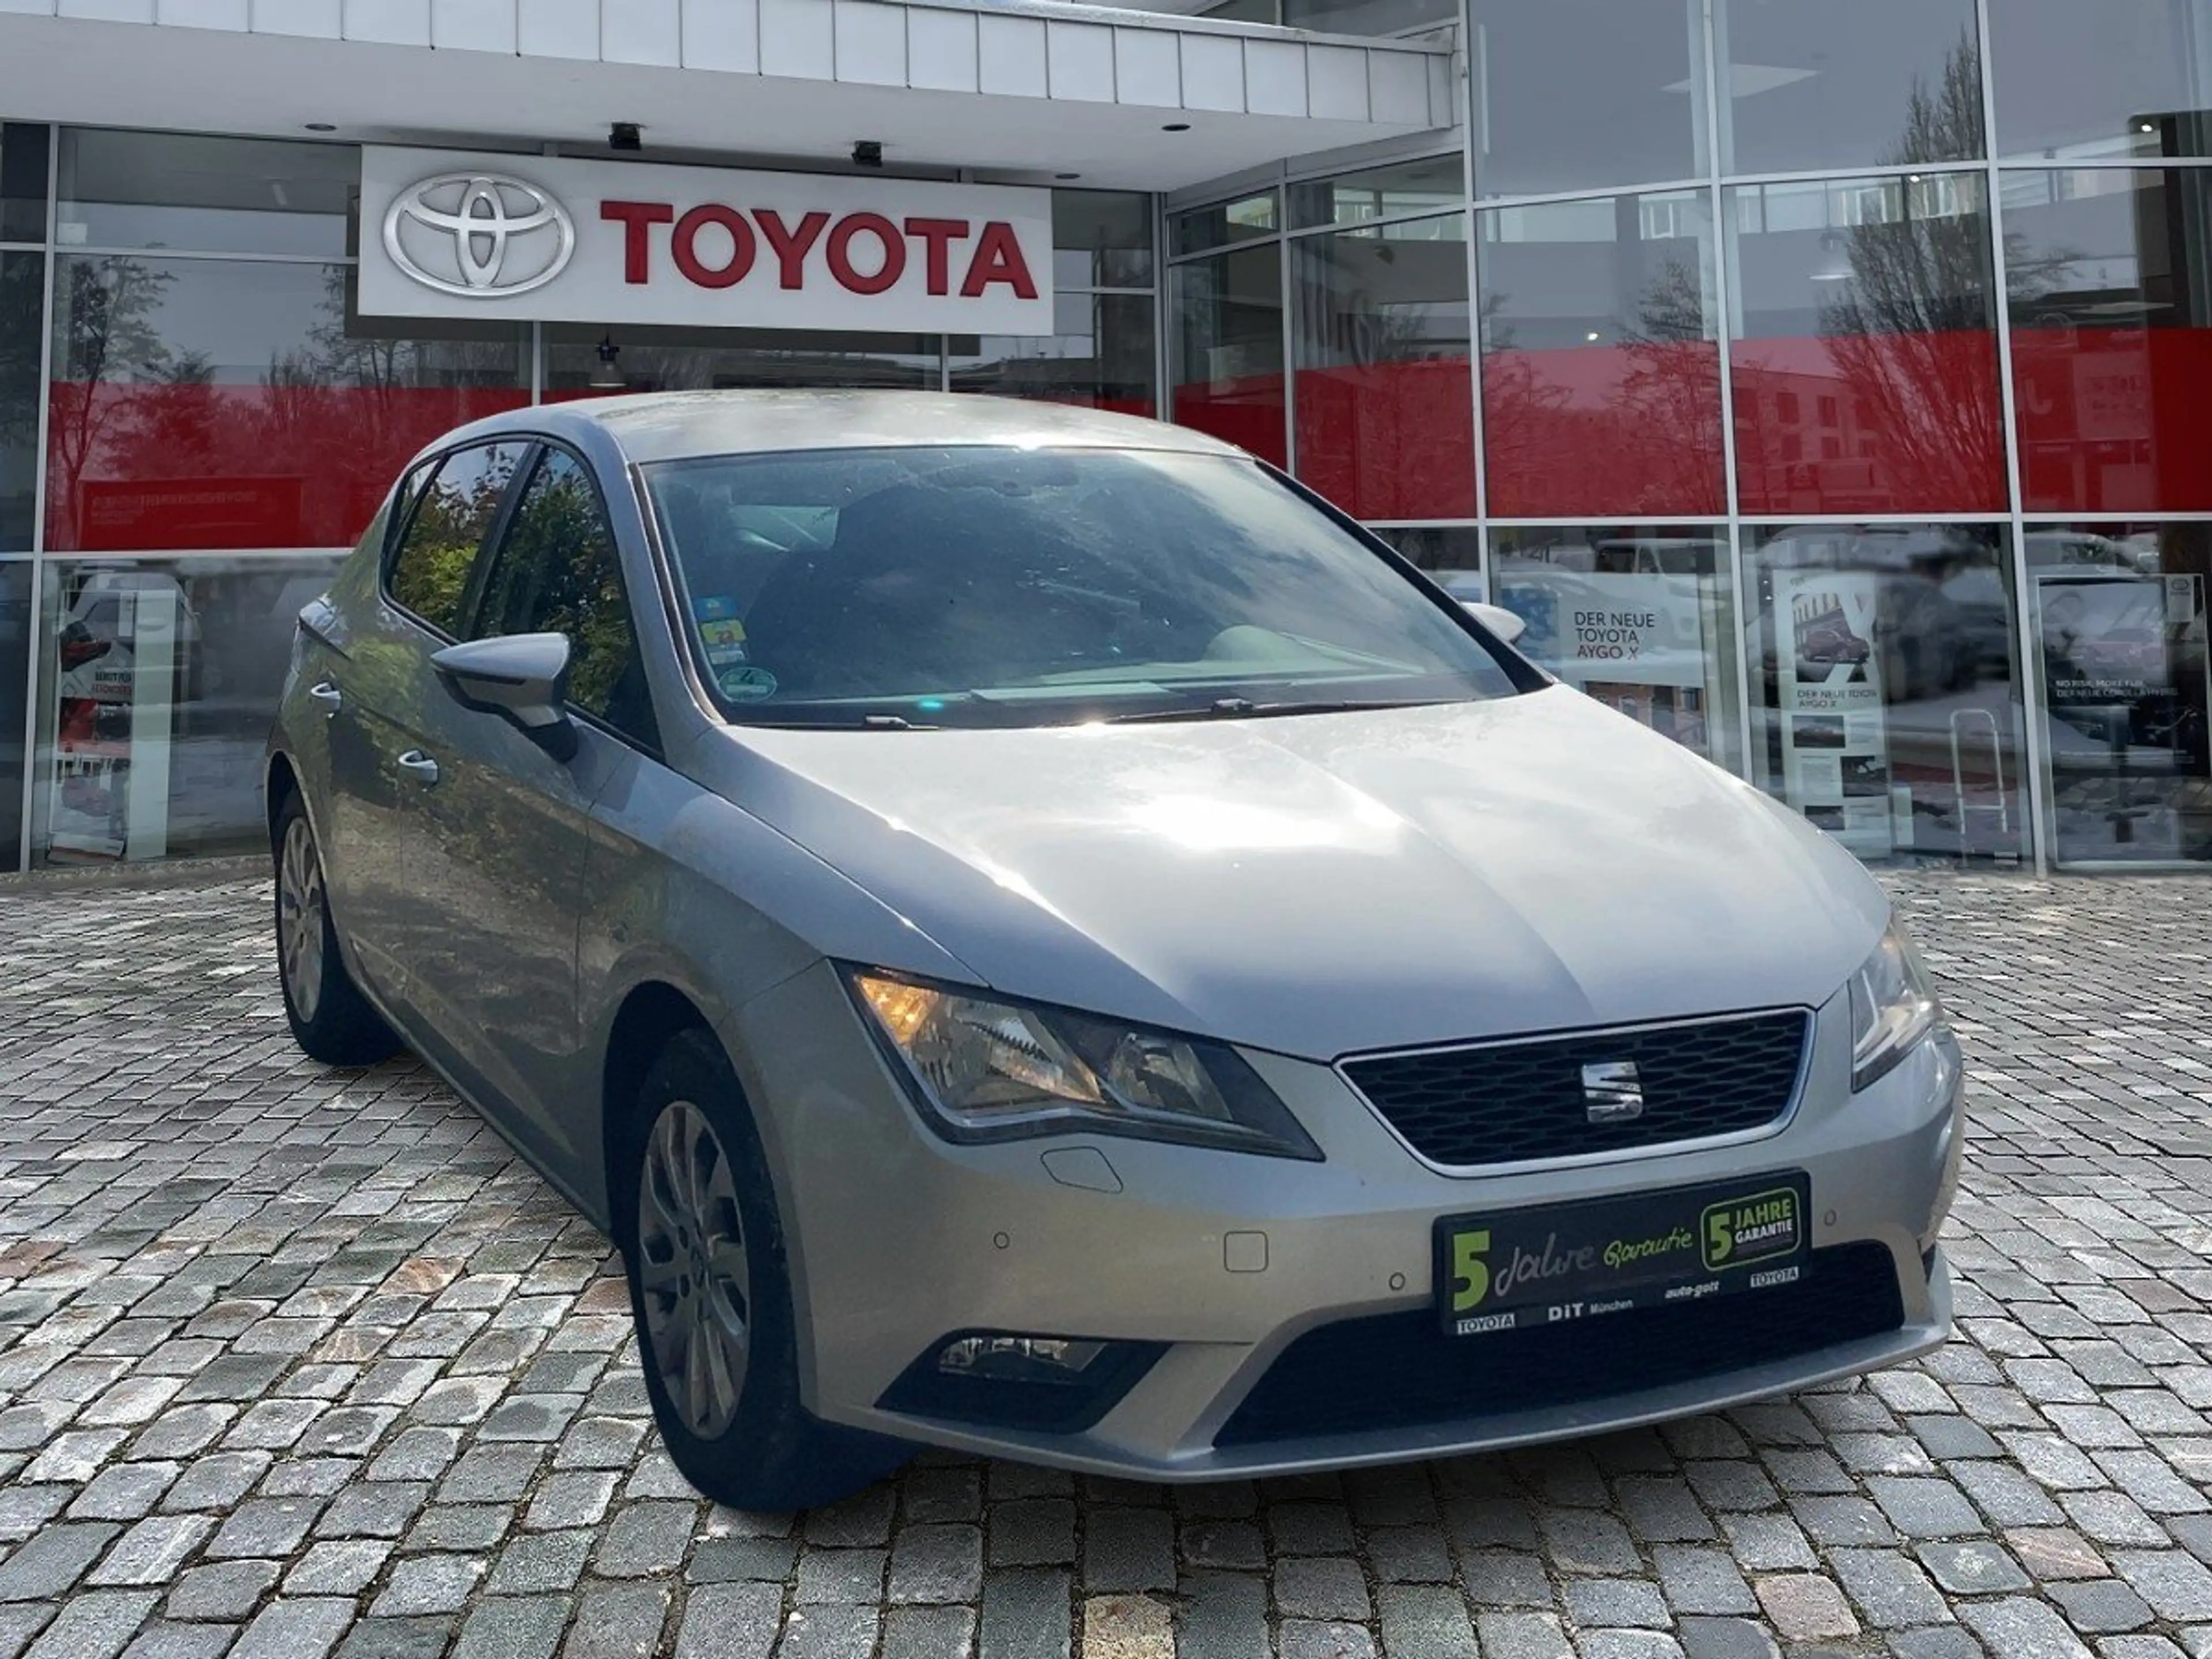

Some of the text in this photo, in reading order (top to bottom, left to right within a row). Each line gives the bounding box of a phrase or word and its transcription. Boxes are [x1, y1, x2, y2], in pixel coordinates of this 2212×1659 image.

[600, 200, 1038, 300] TOYOTA
[1575, 611, 1655, 628] DER NEUE
[1575, 627, 1639, 643] TOYOTA
[1577, 645, 1639, 660] AYGO X
[1735, 1198, 1791, 1229] JAHRE
[1710, 1213, 1732, 1261] 5
[1734, 1218, 1793, 1244] GARANTIE
[1453, 1230, 1490, 1312] 5
[1495, 1233, 1596, 1297] Jahre
[1750, 1266, 1799, 1288] TOYOTA
[1457, 1313, 1515, 1335] TOYOTA
